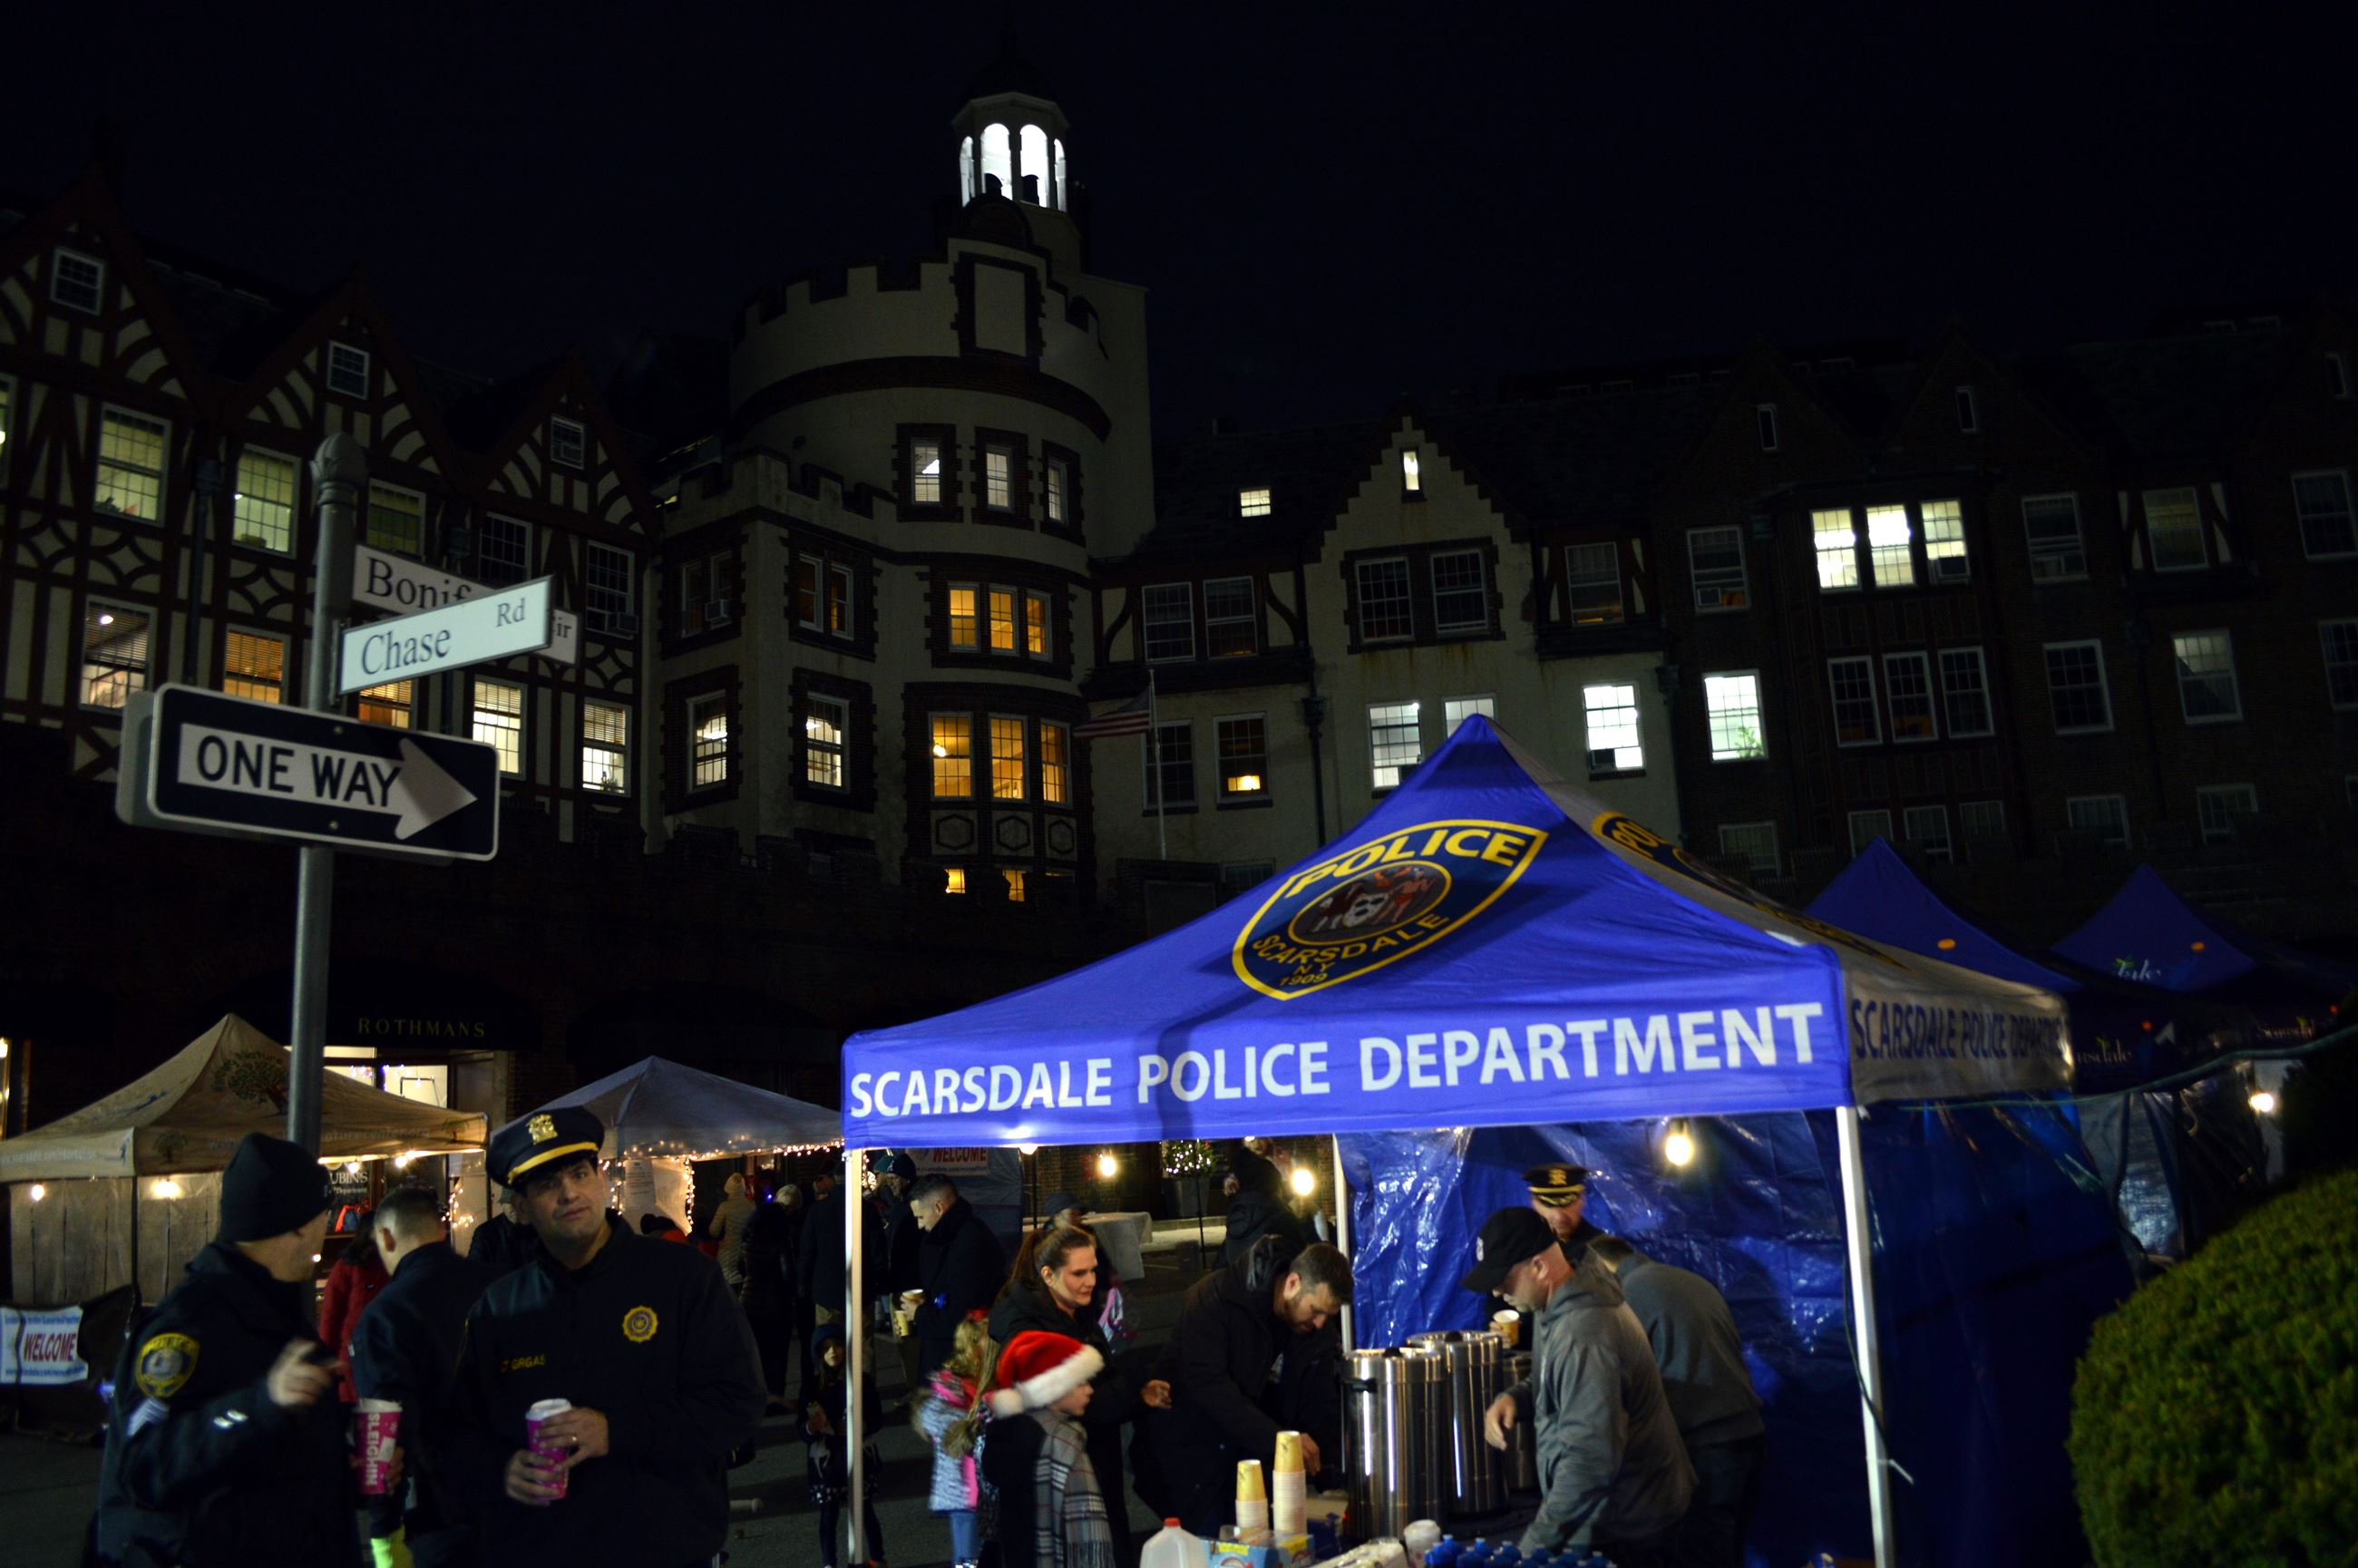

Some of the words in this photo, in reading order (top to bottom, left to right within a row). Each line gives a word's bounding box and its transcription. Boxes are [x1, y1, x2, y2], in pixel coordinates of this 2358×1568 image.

[366, 557, 472, 609] Bonif
[550, 617, 572, 638] ir
[362, 628, 451, 676] Chase
[496, 599, 526, 628] Rd
[198, 735, 295, 794] ONE
[311, 753, 402, 808] WAY
[1284, 829, 1528, 899] POLICE
[1252, 913, 1451, 965] SCARSDALE
[1279, 972, 1330, 987] 1909
[357, 1016, 486, 1038] ROTHMANS
[1851, 998, 1956, 1059] SCARSDALE
[1962, 1010, 2007, 1059] POLICE
[850, 1057, 1112, 1118] SCARSDALE
[1137, 1041, 1331, 1105] POLICE
[1359, 1002, 1824, 1092] DEPARTMENT
[932, 1147, 987, 1163] WELCOME
[24, 1333, 77, 1361] WELCOME
